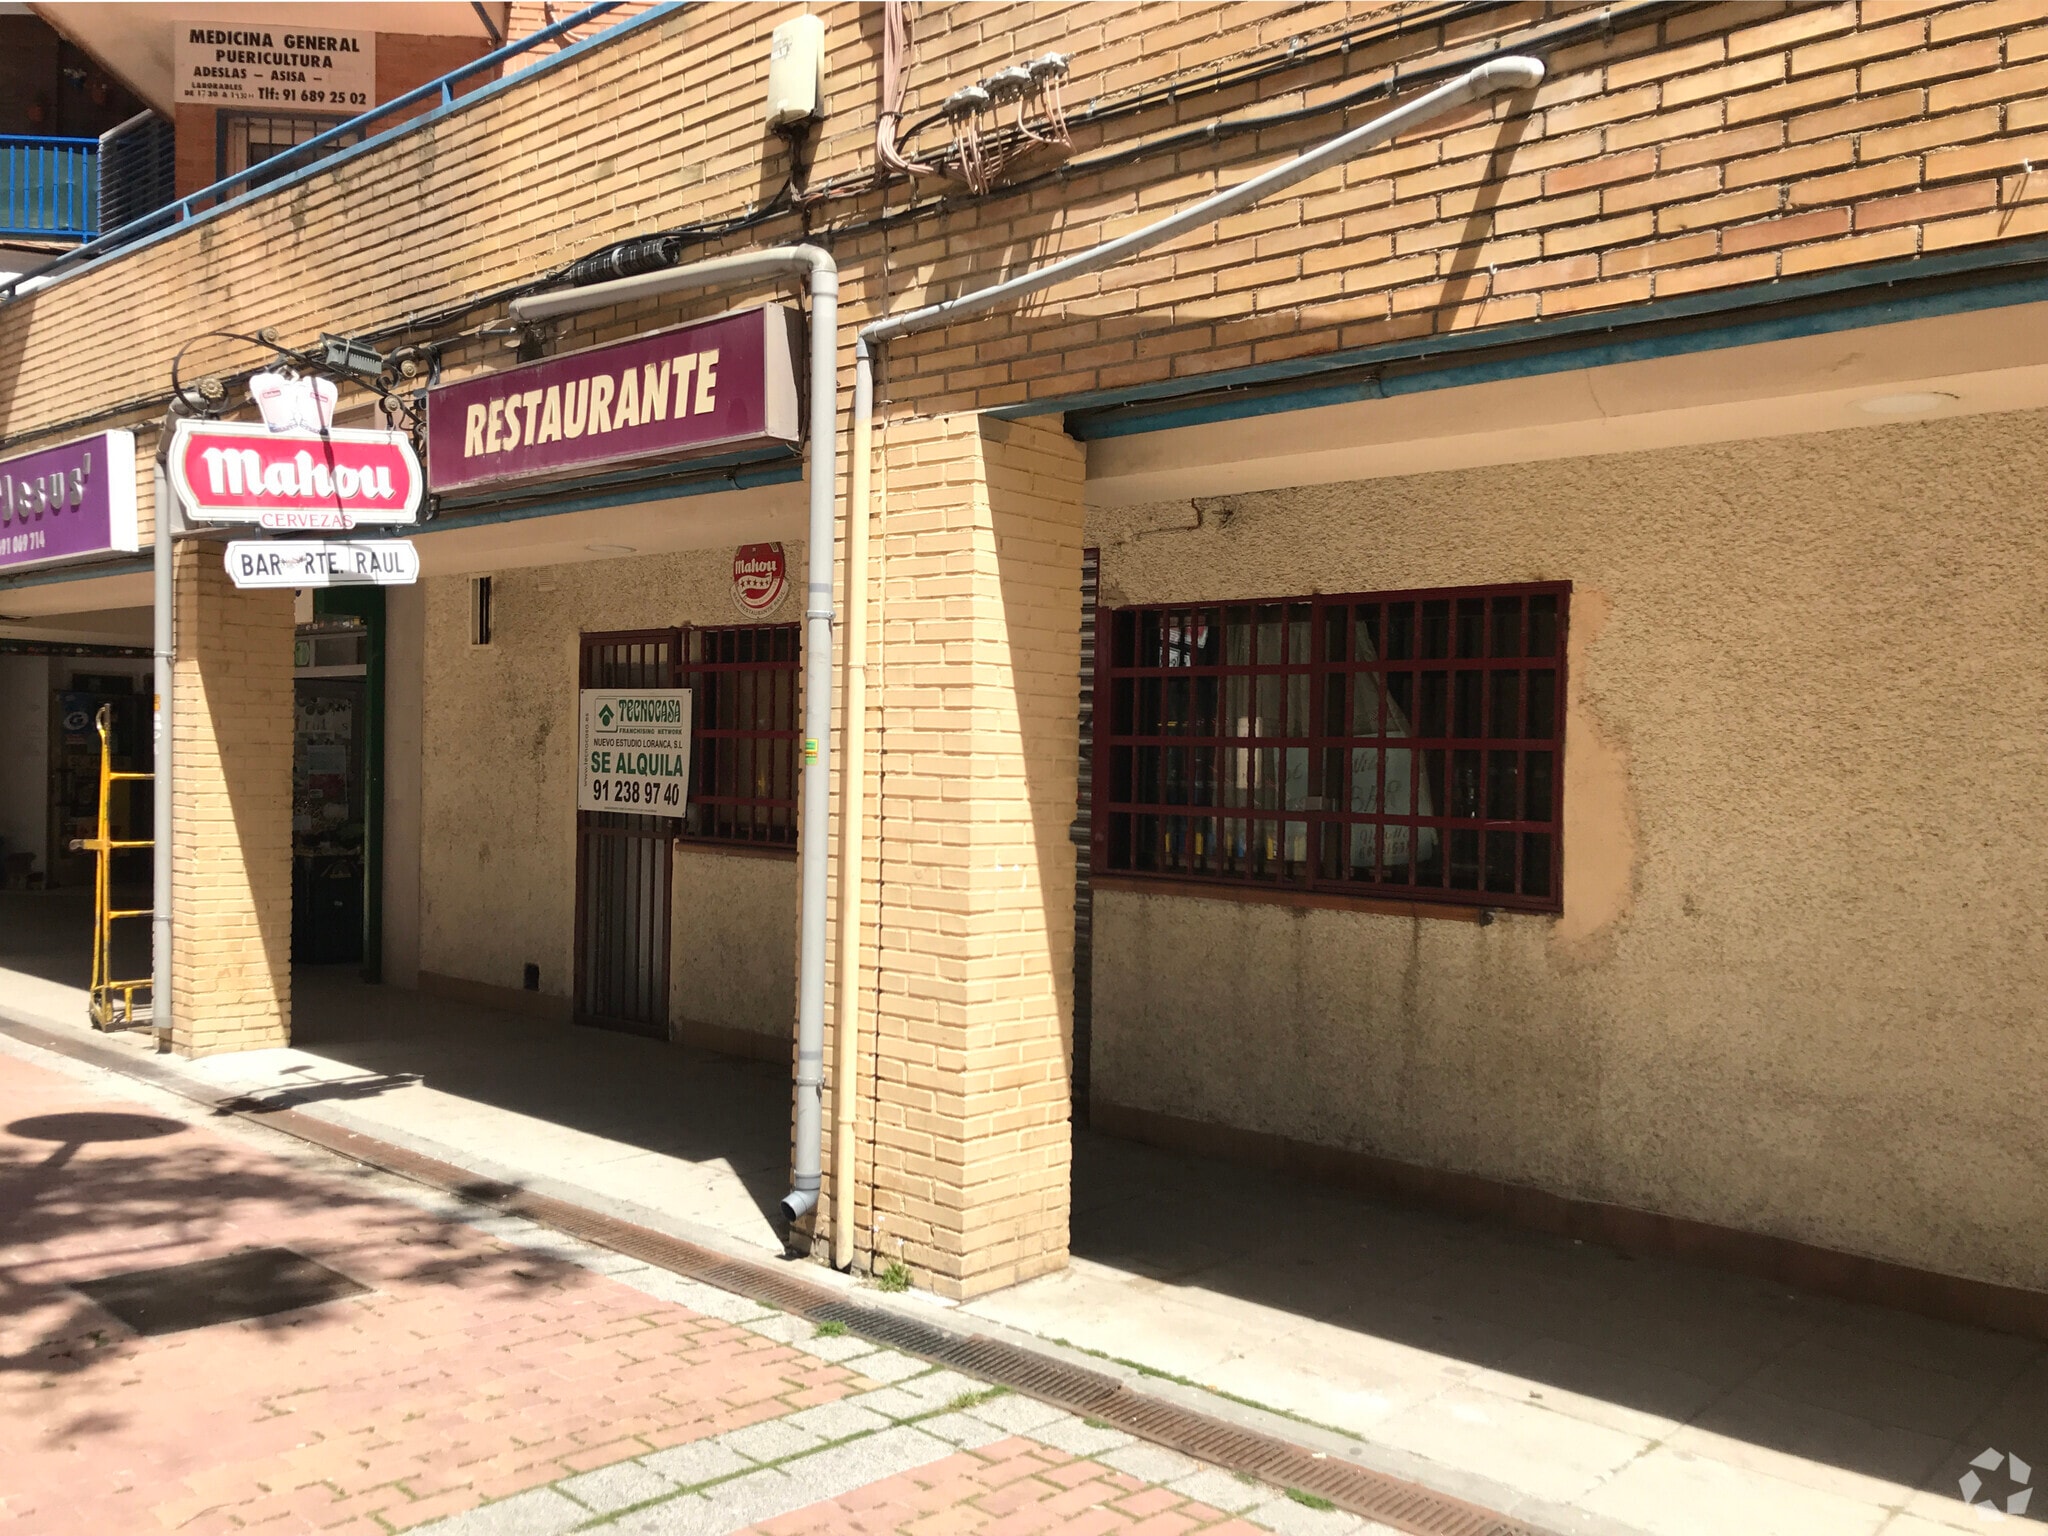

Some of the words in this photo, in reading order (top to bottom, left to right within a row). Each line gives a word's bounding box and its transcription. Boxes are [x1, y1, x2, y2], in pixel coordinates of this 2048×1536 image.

[190, 29, 273, 48] MEDICINA
[284, 34, 360, 52] GENERAL
[216, 49, 333, 68] PUERICULTURA
[193, 66, 247, 79] ADESLAS
[271, 70, 306, 82] ASISA
[192, 82, 243, 91] LABORABLES
[258, 87, 279, 100] Tlf:
[282, 89, 296, 101] 91
[301, 90, 325, 102] 689
[330, 91, 346, 103] 25
[350, 92, 367, 104] 02
[464, 348, 720, 458] RESTAURANTE
[201, 446, 395, 500] Mahou
[261, 512, 353, 529] CERVEZAS
[240, 553, 282, 577] BAR
[356, 551, 405, 574] RAUL
[735, 558, 777, 575] Mahou
[618, 699, 681, 723] TECNOCASA
[594, 739, 615, 747] NUEVO
[616, 739, 642, 748] ESTUDIO
[643, 740, 673, 750] LORANCA,
[591, 751, 611, 774] SE
[616, 752, 683, 777] ALQUILA
[593, 779, 609, 801] 91
[615, 780, 640, 803] 238
[645, 782, 661, 804] 97
[664, 783, 680, 806] 40
